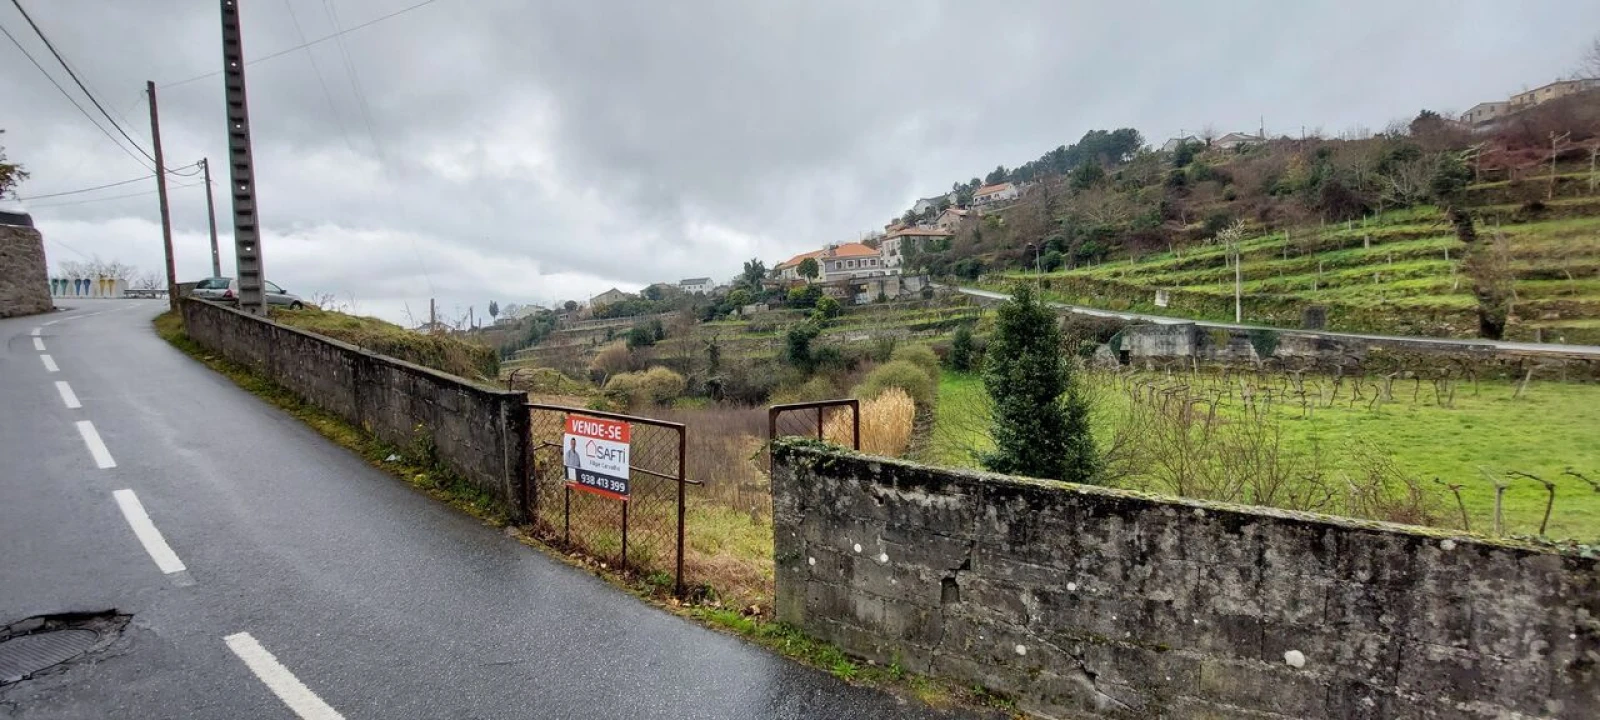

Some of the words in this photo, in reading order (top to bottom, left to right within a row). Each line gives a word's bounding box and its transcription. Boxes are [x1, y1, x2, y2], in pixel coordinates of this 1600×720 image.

[572, 419, 621, 439] VENDE-SE
[580, 474, 595, 485] 938
[596, 477, 609, 488] 413
[610, 480, 625, 492] 399
